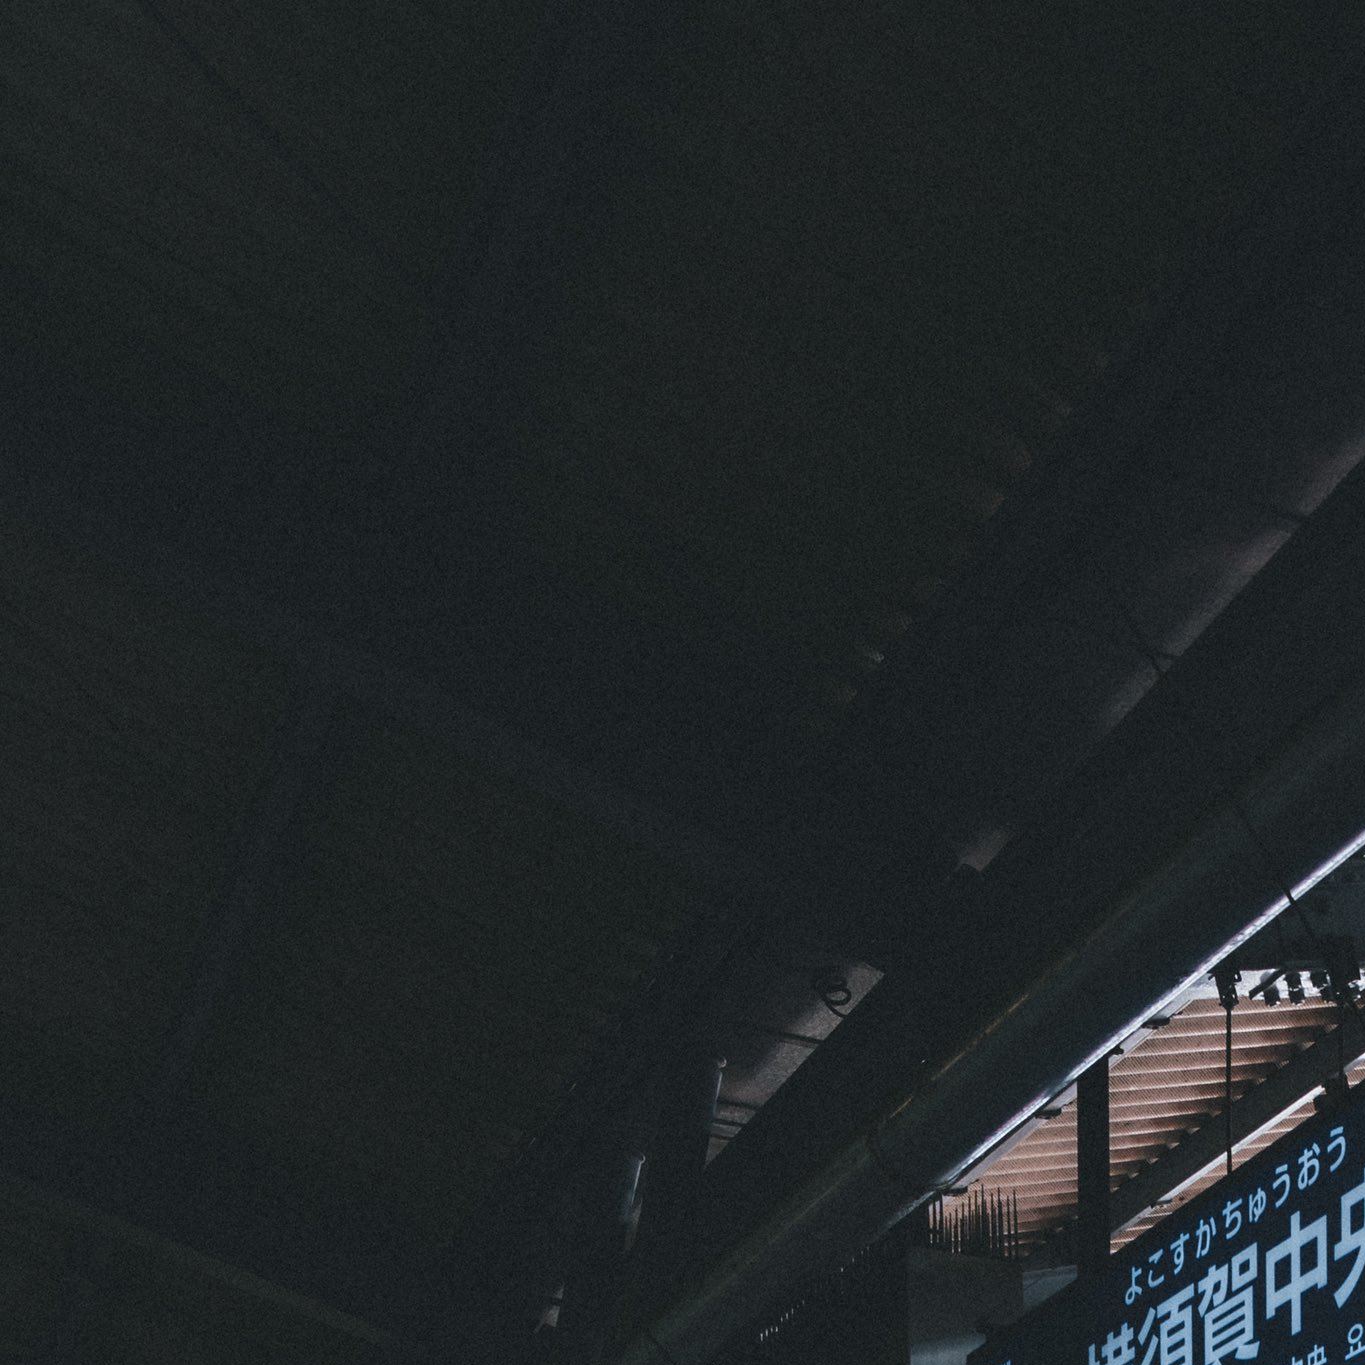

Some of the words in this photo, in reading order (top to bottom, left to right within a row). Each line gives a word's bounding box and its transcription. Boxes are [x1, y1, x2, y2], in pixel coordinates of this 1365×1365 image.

[1125, 1126, 1346, 1305] よこすかちゅうおう
